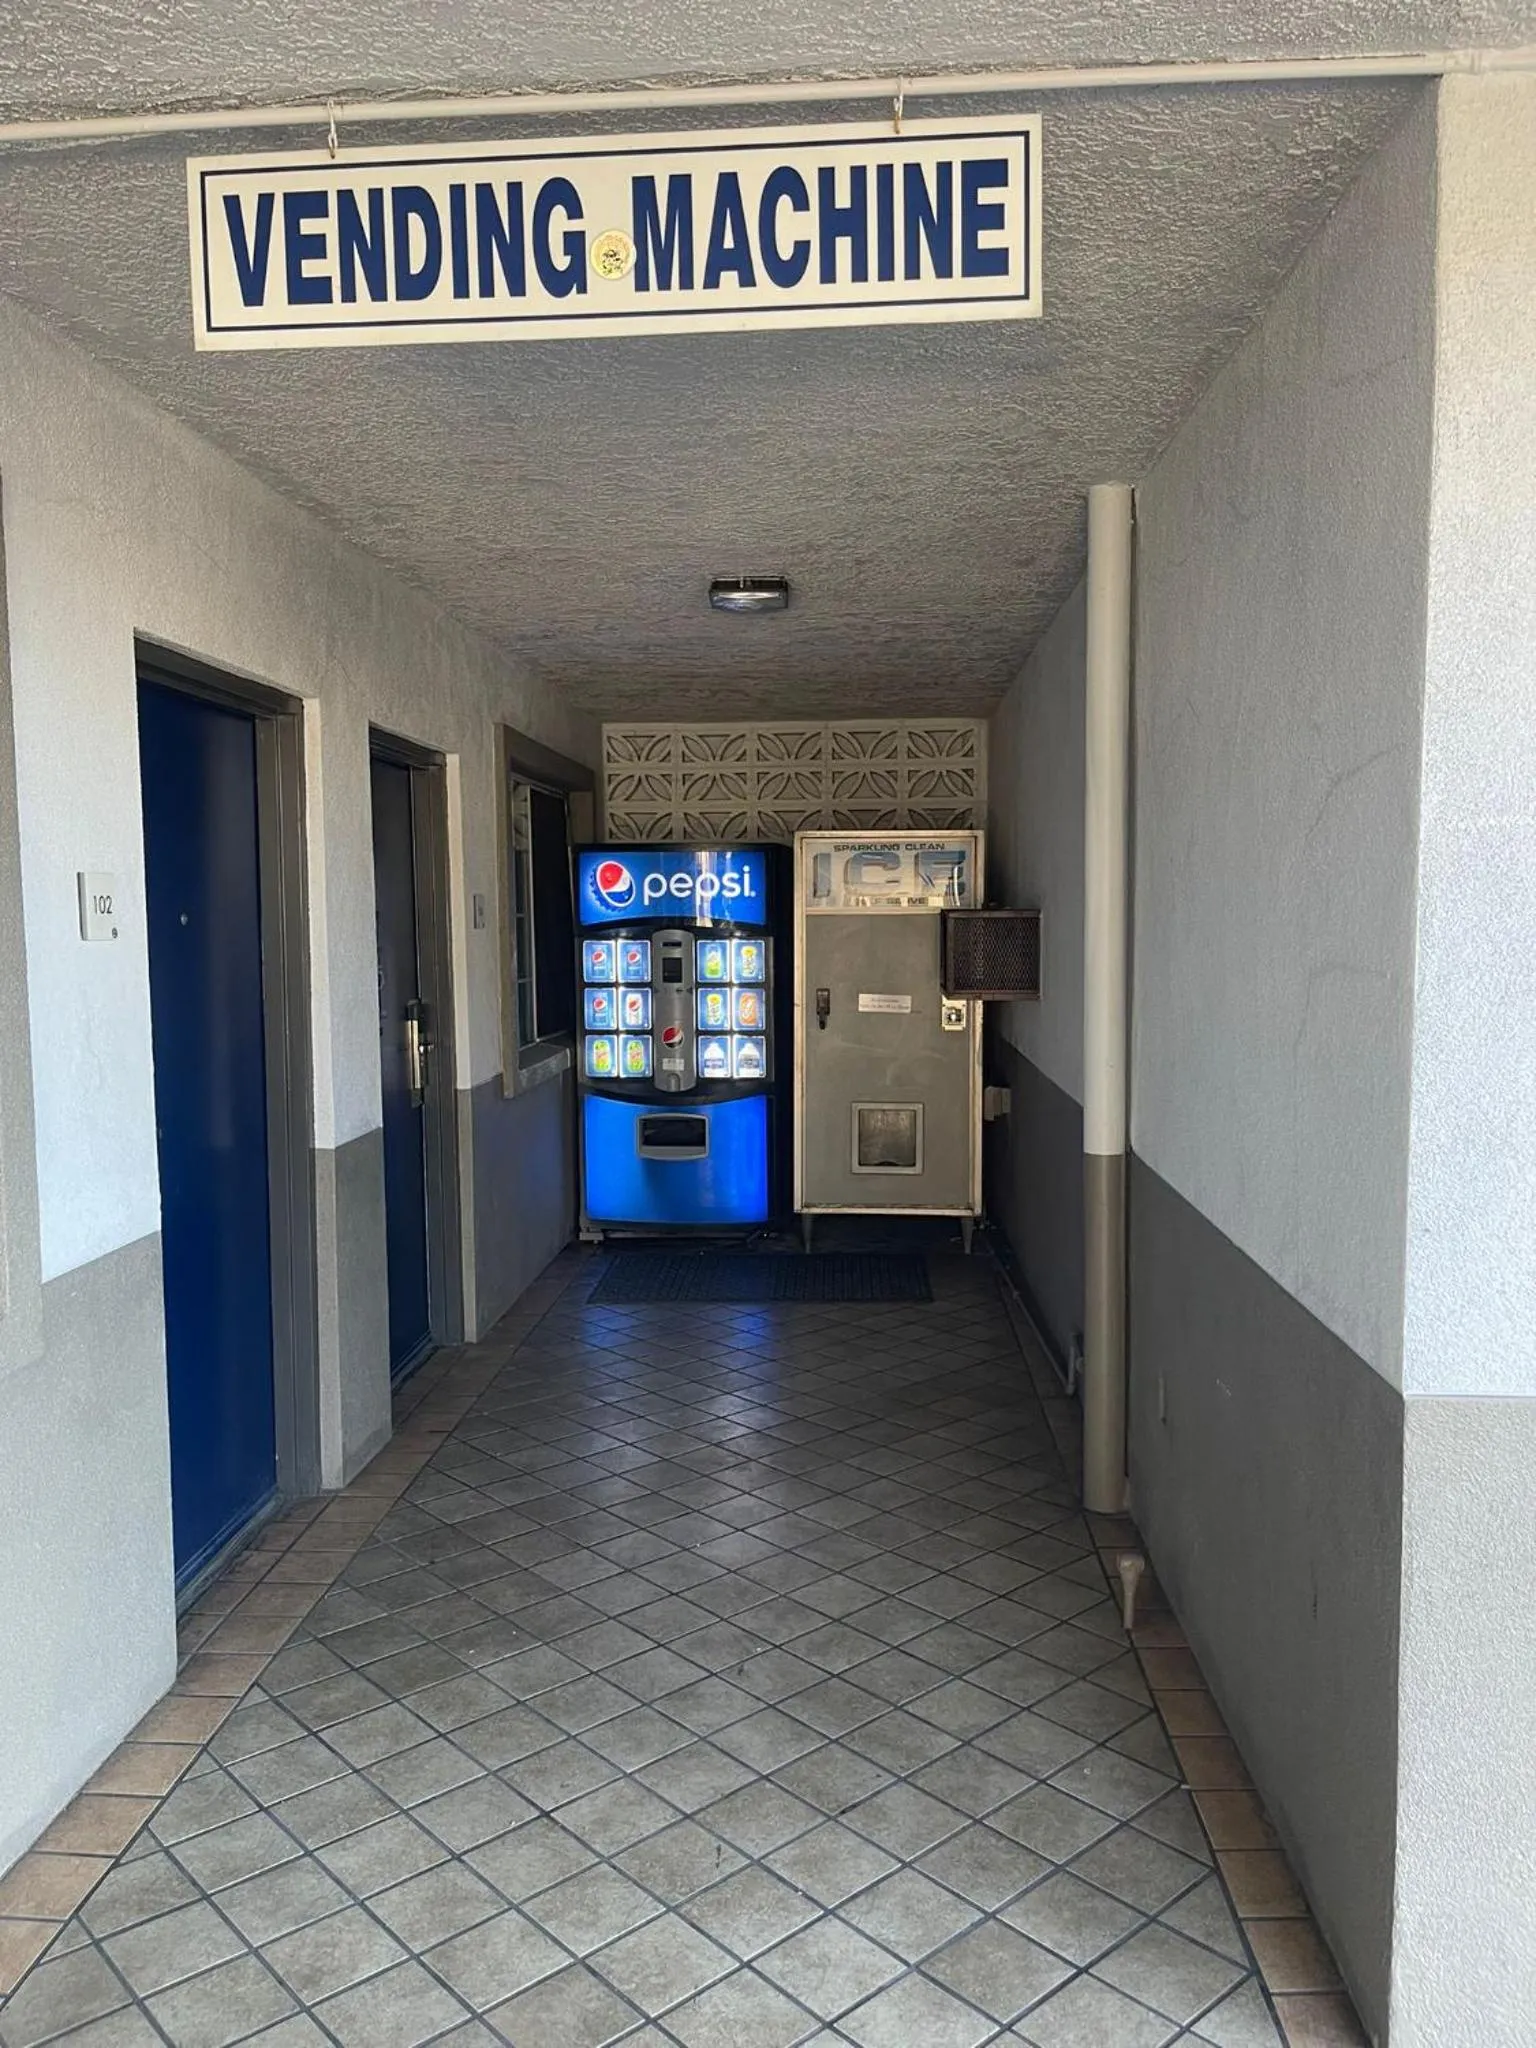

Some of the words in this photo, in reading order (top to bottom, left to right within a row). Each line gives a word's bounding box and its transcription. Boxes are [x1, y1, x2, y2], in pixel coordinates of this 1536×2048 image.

[223, 178, 588, 306] VENDING
[634, 159, 1009, 291] MACHINE
[834, 843, 900, 852] SPARKLING
[93, 895, 112, 914] 102
